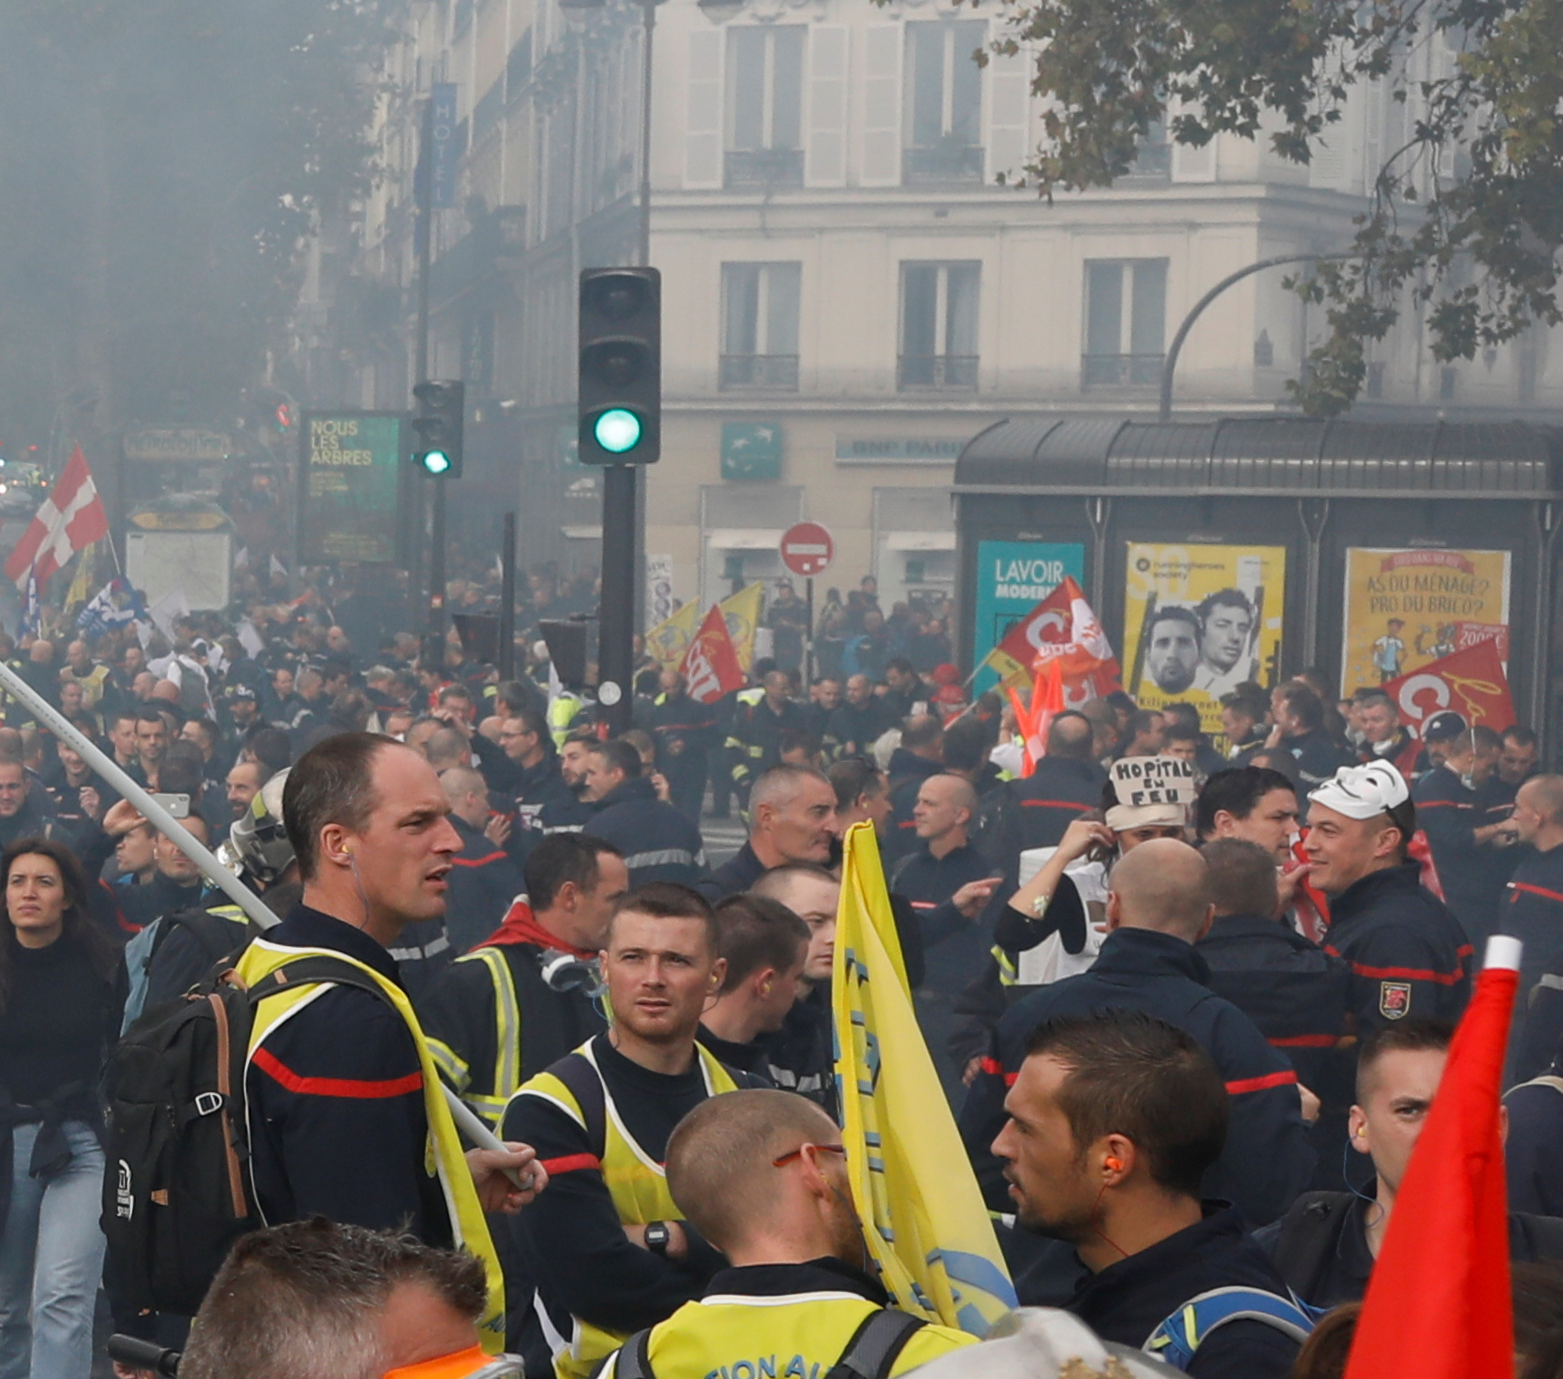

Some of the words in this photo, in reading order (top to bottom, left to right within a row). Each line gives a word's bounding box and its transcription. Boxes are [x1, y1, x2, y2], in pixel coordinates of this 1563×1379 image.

[434, 105, 450, 202] HOTEL
[311, 421, 358, 436] NOUS
[311, 436, 339, 451] LES
[311, 450, 373, 466] ARBRES
[996, 558, 1064, 584] LAVOIR
[1370, 597, 1394, 614] PRO
[1403, 597, 1423, 613] DU
[1131, 788, 1178, 806] FEU
